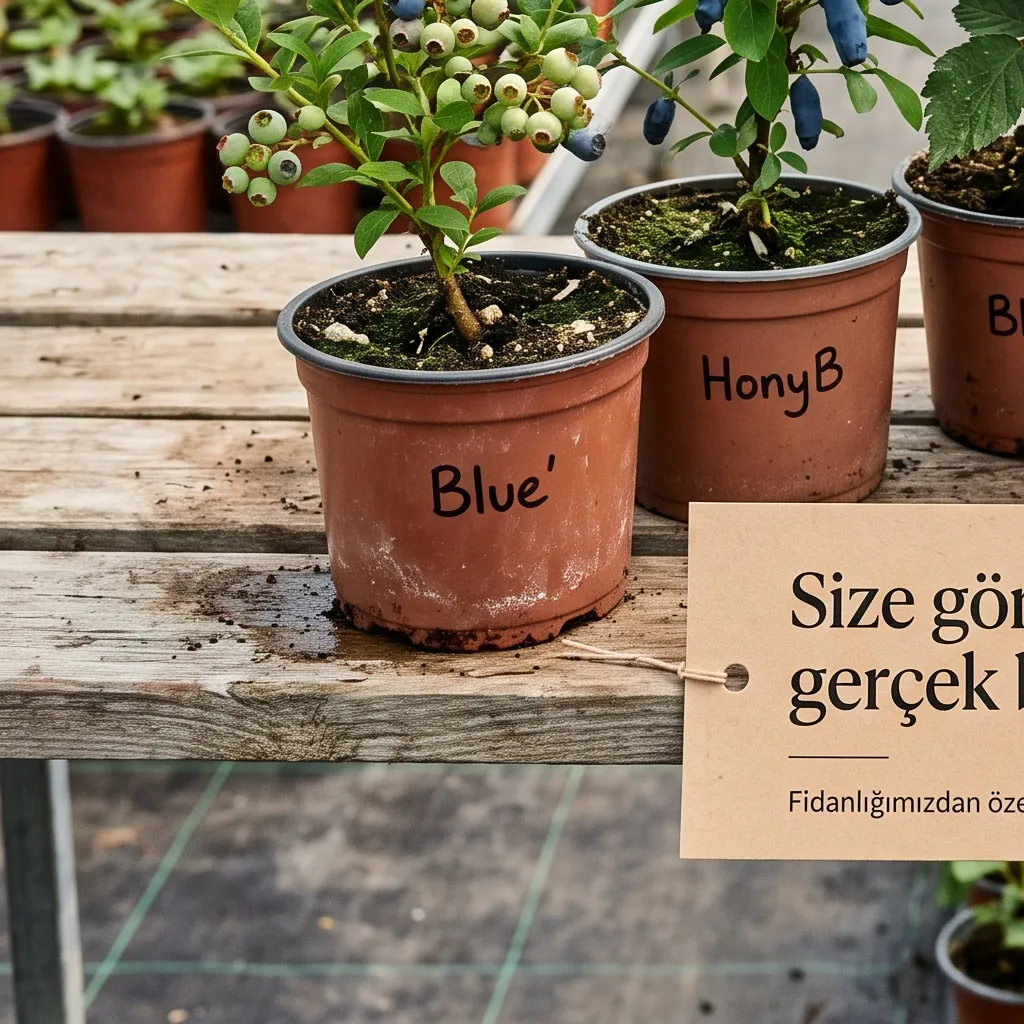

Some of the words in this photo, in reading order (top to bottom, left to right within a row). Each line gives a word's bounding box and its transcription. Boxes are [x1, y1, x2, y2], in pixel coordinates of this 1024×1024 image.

[702, 346, 844, 418] HonyB
[791, 571, 915, 630] Size
[789, 651, 1001, 728] gerçek
[789, 789, 980, 819] Fidanlığımızdan
